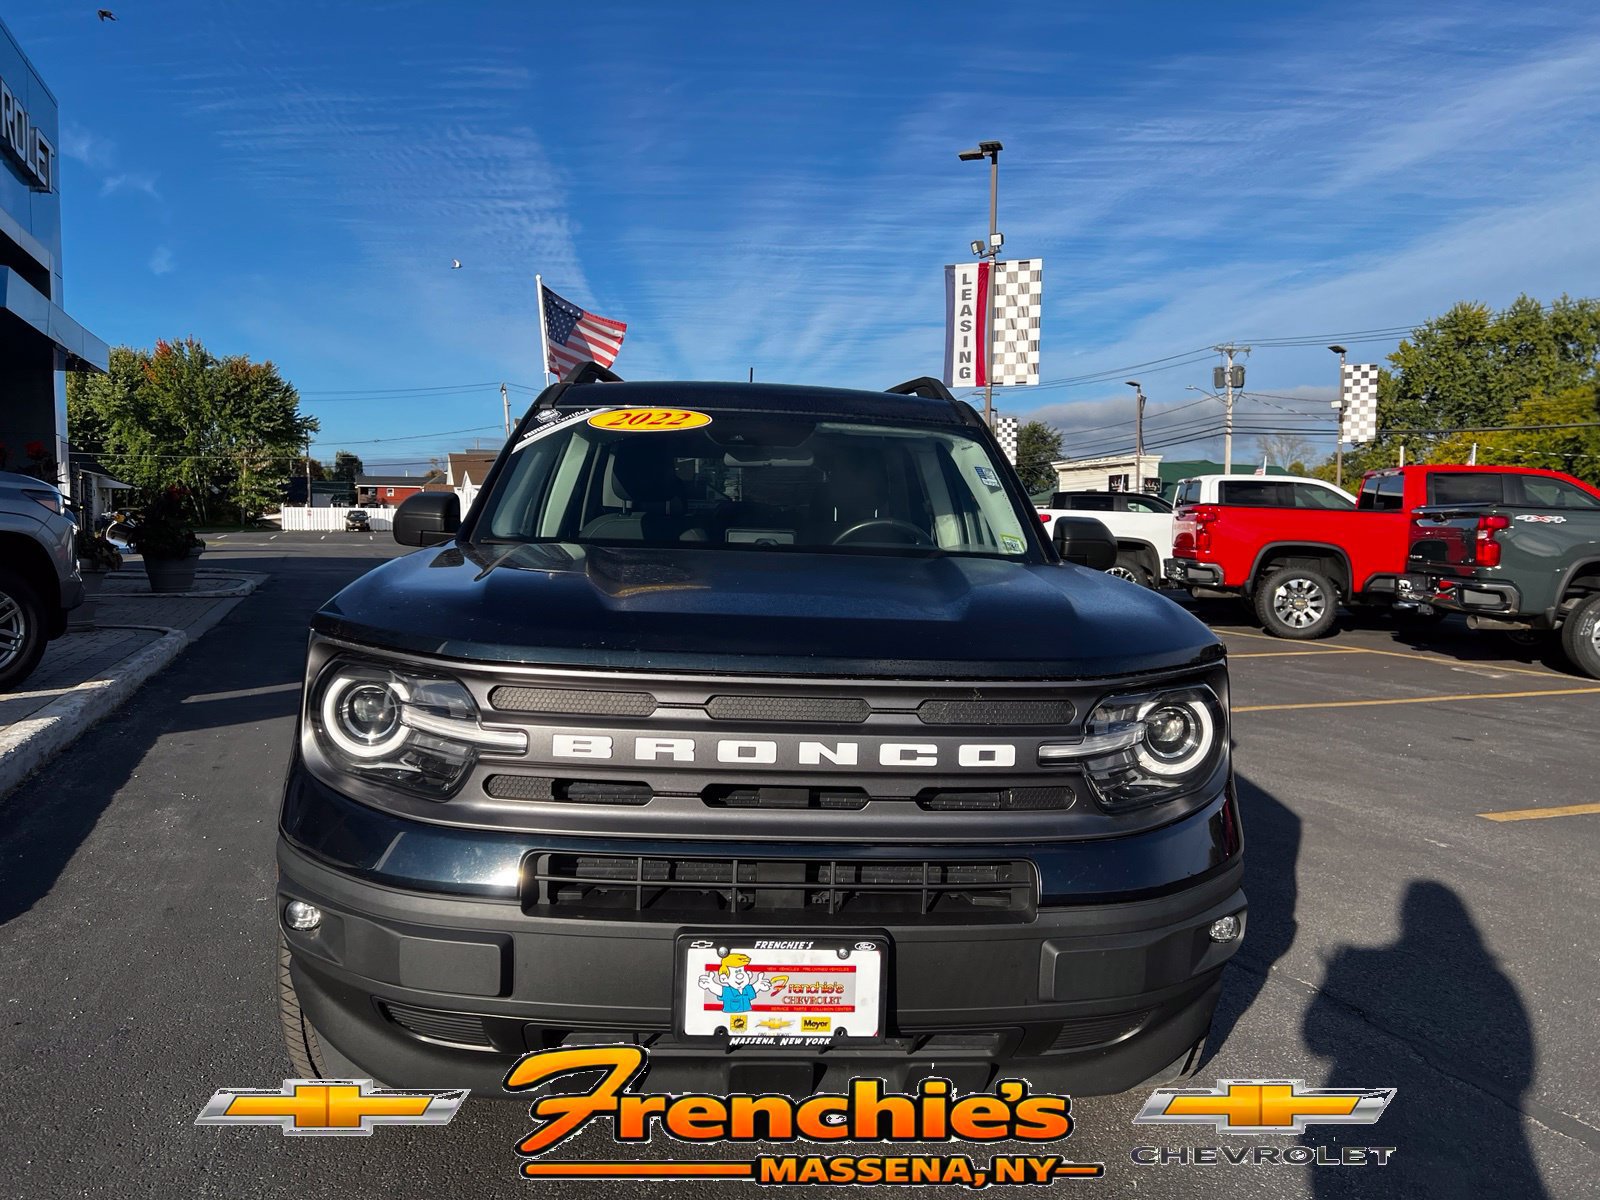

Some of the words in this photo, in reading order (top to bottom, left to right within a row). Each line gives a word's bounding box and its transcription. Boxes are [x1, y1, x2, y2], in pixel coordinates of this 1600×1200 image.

[959, 273, 973, 379] LEASING
[606, 412, 692, 427] 2022
[552, 734, 1016, 767] BRONCO
[754, 941, 814, 950] FRENCHIE'S
[770, 975, 844, 997] Frenchie's
[782, 996, 842, 1005] CHEVROLET
[780, 1037, 803, 1046] NEW
[805, 1037, 831, 1046] YORK
